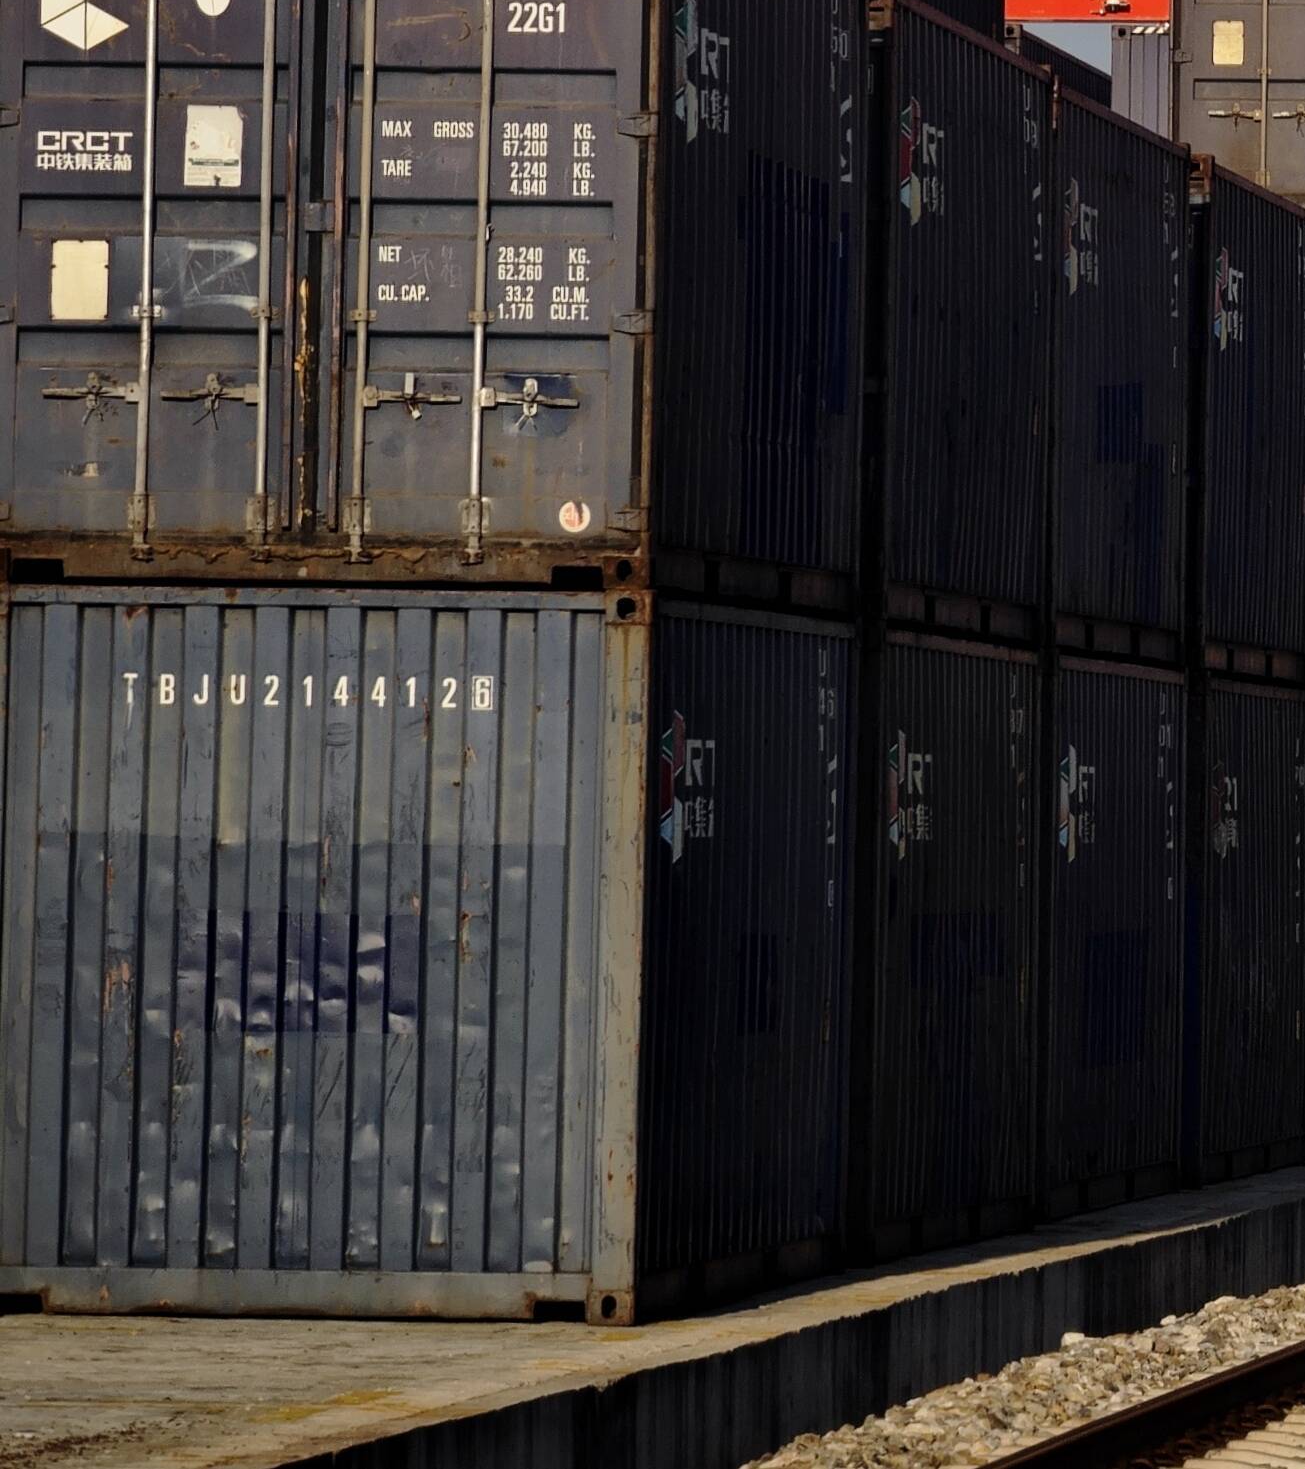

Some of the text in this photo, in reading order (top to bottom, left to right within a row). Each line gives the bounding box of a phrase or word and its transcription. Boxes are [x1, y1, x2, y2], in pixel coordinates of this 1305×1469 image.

[508, 3, 566, 33] 22G1
[381, 121, 596, 140] MAX GROSS 30.480 KG.
[37, 132, 132, 150] CRCT
[573, 141, 595, 157] LB.
[37, 153, 132, 171] 中铁集装箱
[381, 160, 595, 179] TARE 2.240 KG.
[510, 179, 595, 196] 4.940 LB.
[378, 246, 590, 264] NET 28.240 KG.
[498, 265, 589, 282] 62.260 LB.
[505, 287, 534, 303] 33.2
[498, 304, 533, 320] 1.170
[122, 673, 494, 710] TBJU2144126
